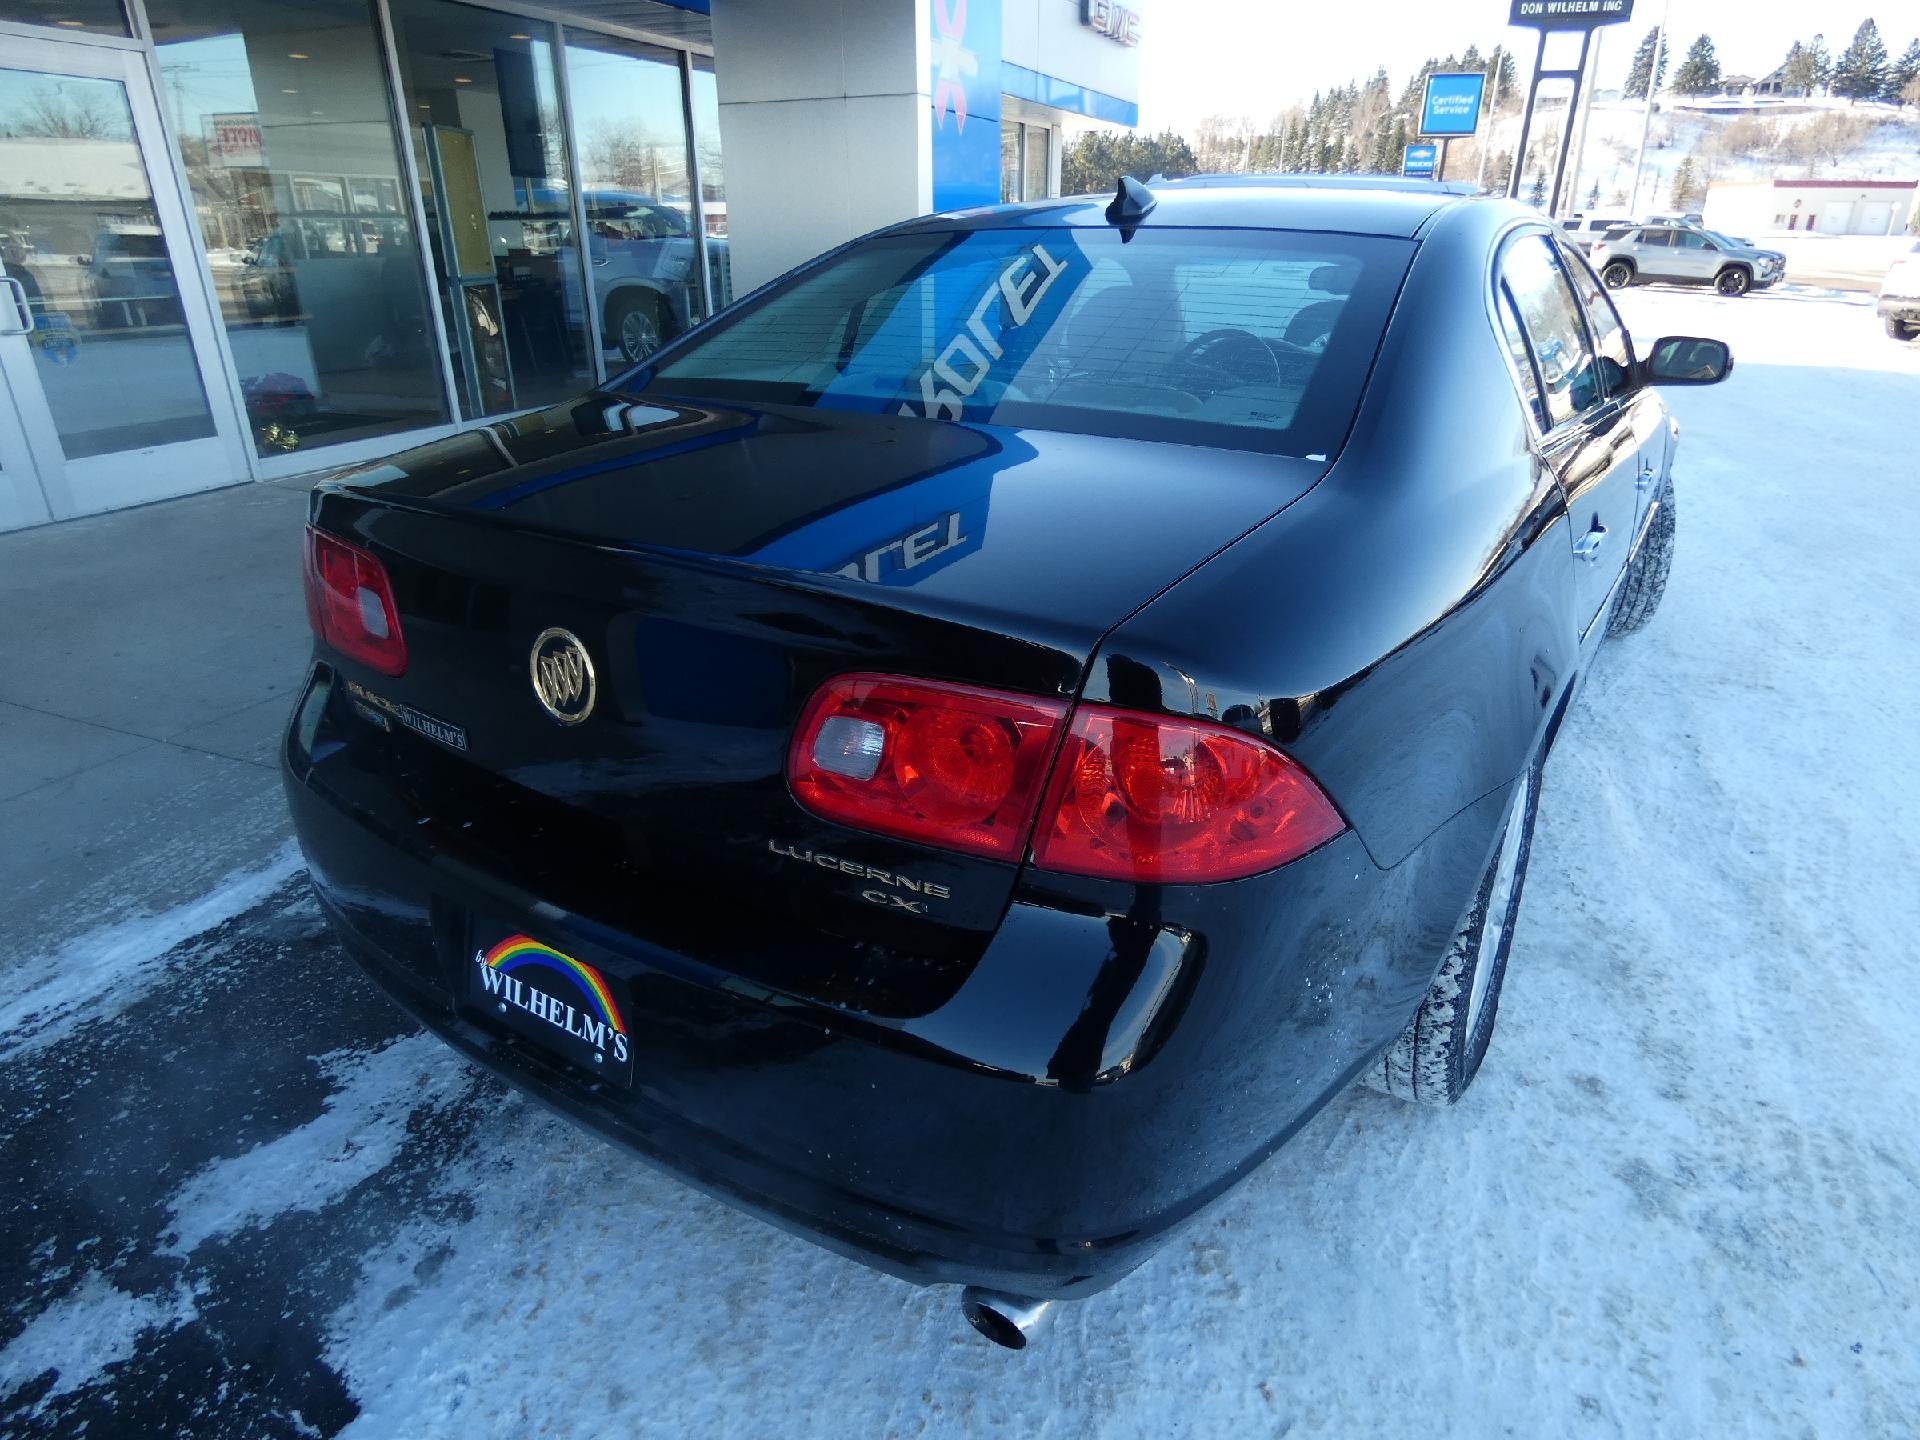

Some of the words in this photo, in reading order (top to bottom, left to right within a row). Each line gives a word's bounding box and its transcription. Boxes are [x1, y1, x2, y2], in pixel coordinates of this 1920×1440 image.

[1081, 0, 1141, 48] GMC
[1520, 3, 1542, 14] DON
[1547, 1, 1598, 13] WILHELM
[1603, 0, 1622, 11] INC
[1432, 95, 1475, 105] Certified
[1432, 105, 1471, 115] Service
[401, 711, 465, 747] WILHELM'S
[768, 839, 951, 899] LUCERNE
[479, 966, 629, 1063] WILHELM'S
